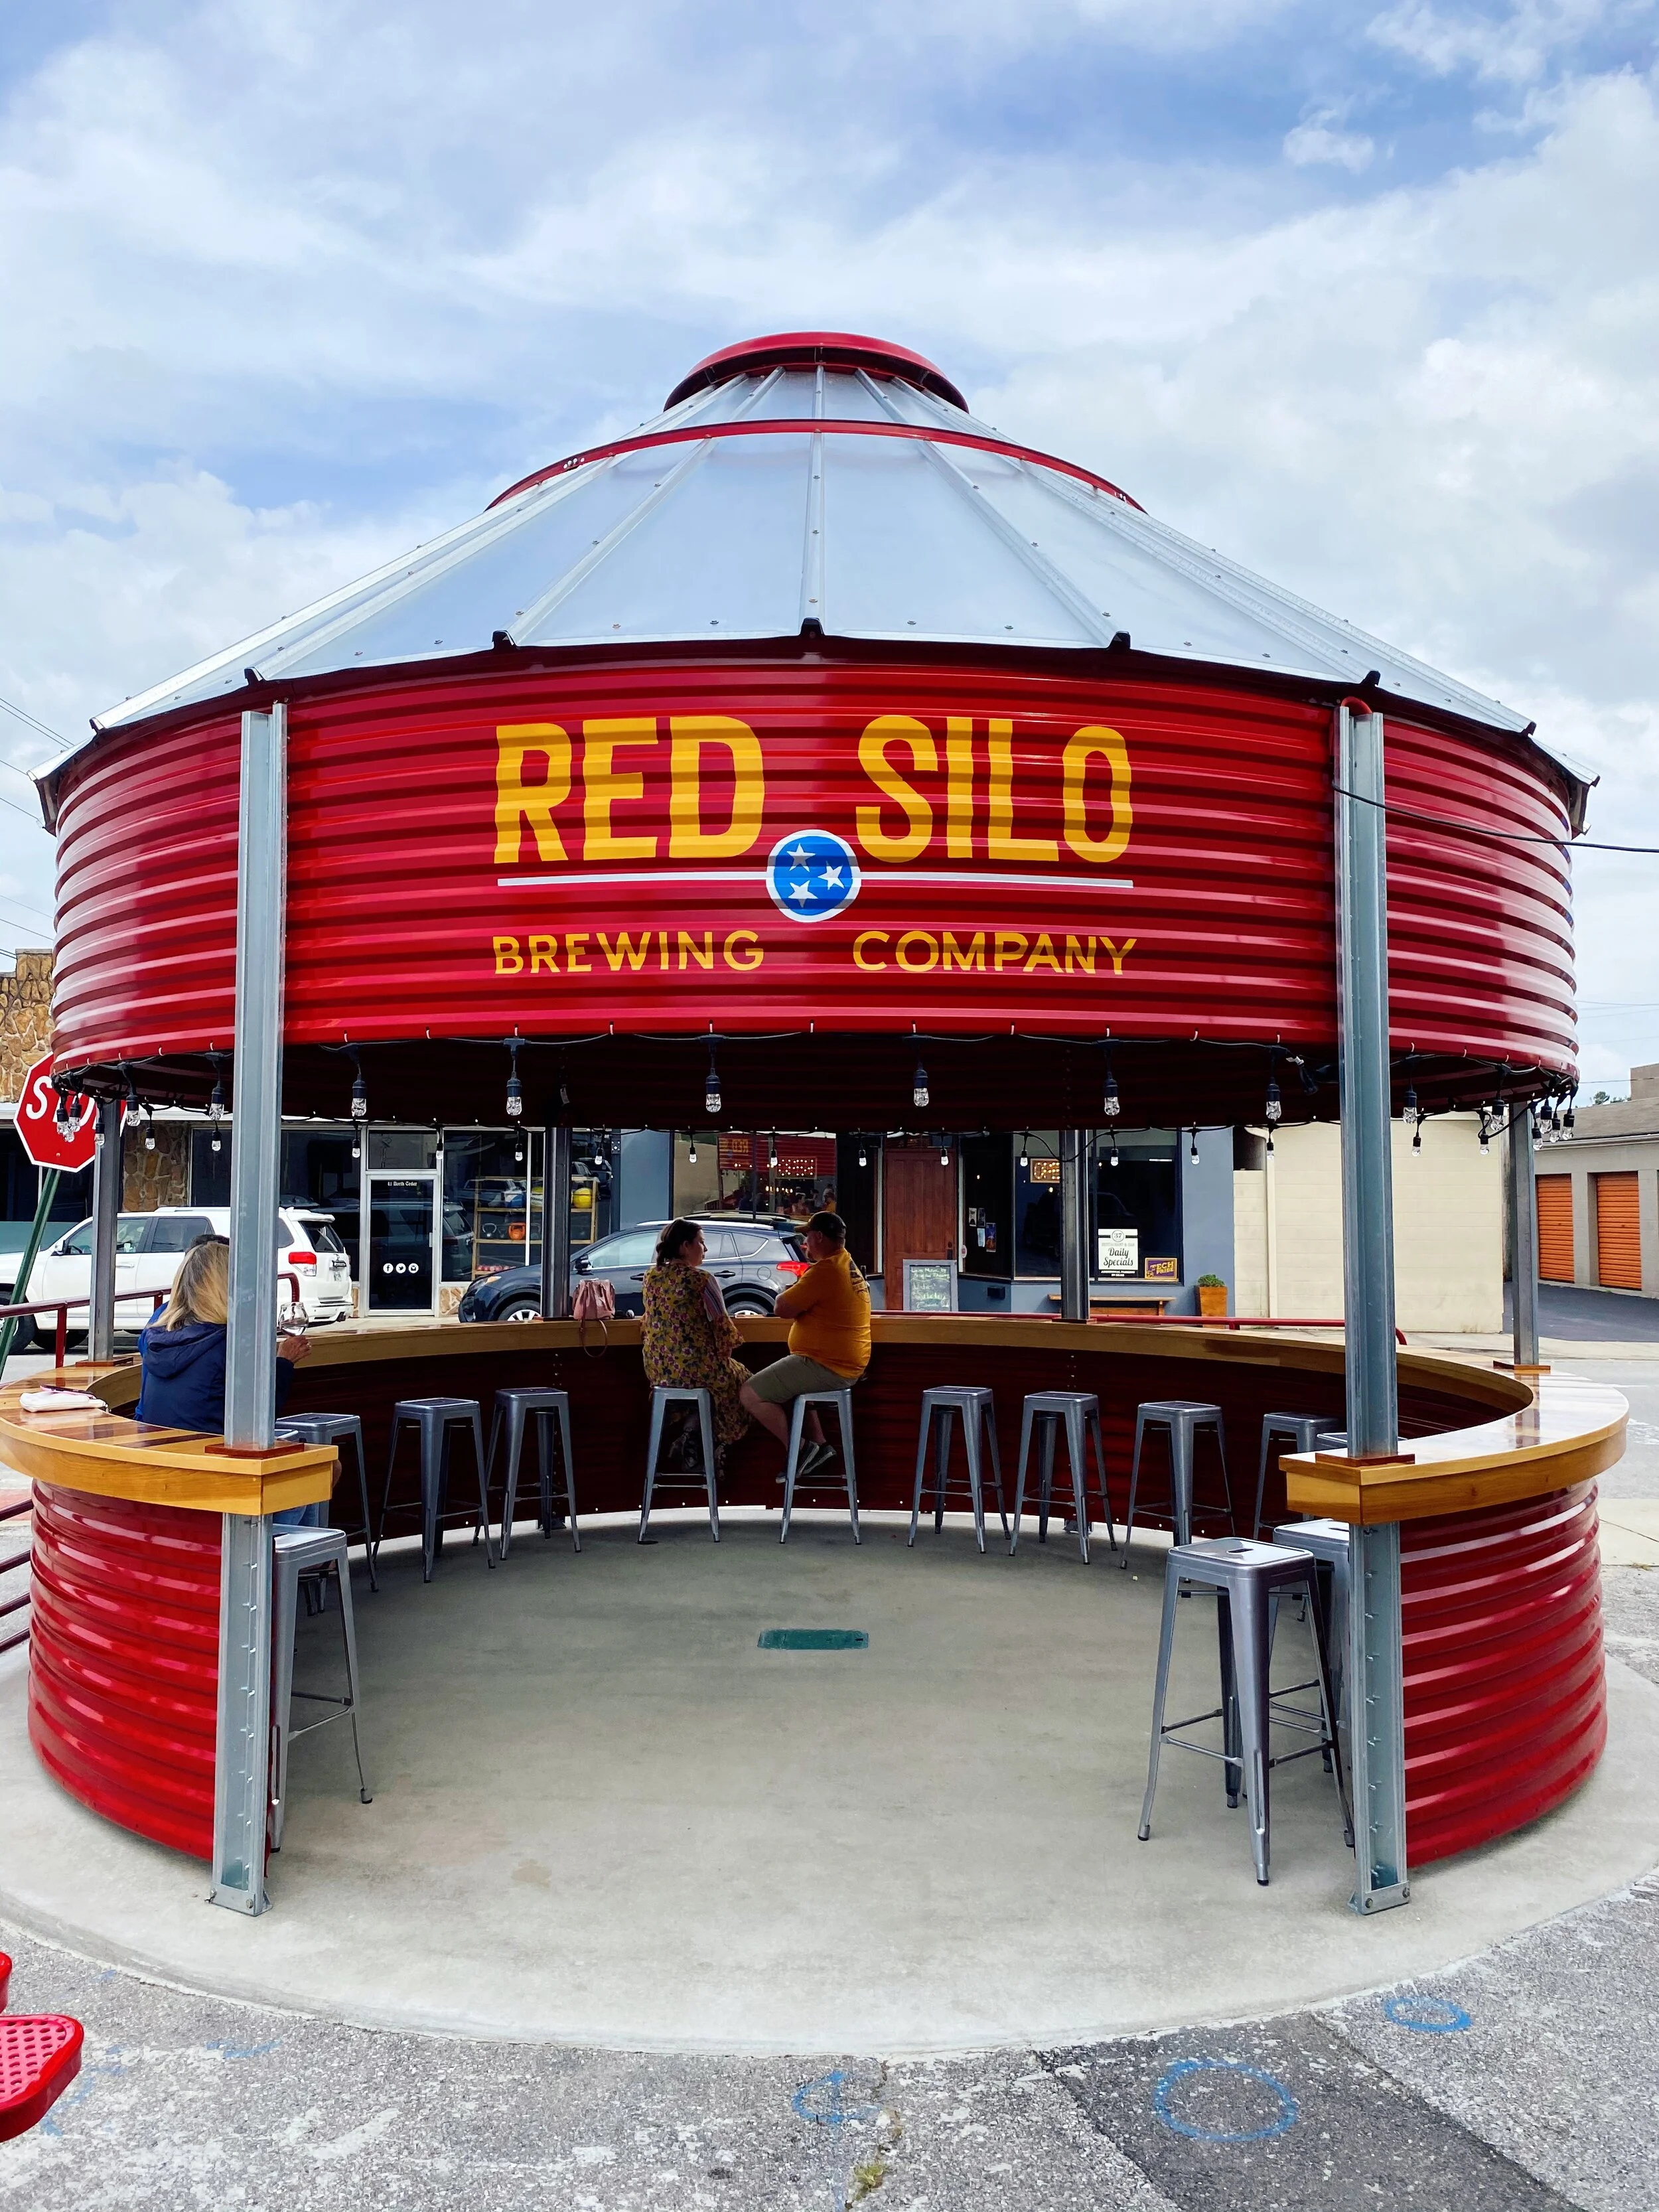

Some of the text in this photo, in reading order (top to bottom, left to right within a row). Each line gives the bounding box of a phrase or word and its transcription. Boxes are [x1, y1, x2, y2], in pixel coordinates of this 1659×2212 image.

[494, 714, 1133, 863] RED SILO
[492, 930, 1137, 976] BREWING COMPANY
[1108, 1247, 1129, 1259] Daily
[1103, 1256, 1133, 1268] Specials
[1150, 1261, 1174, 1271] TECH
